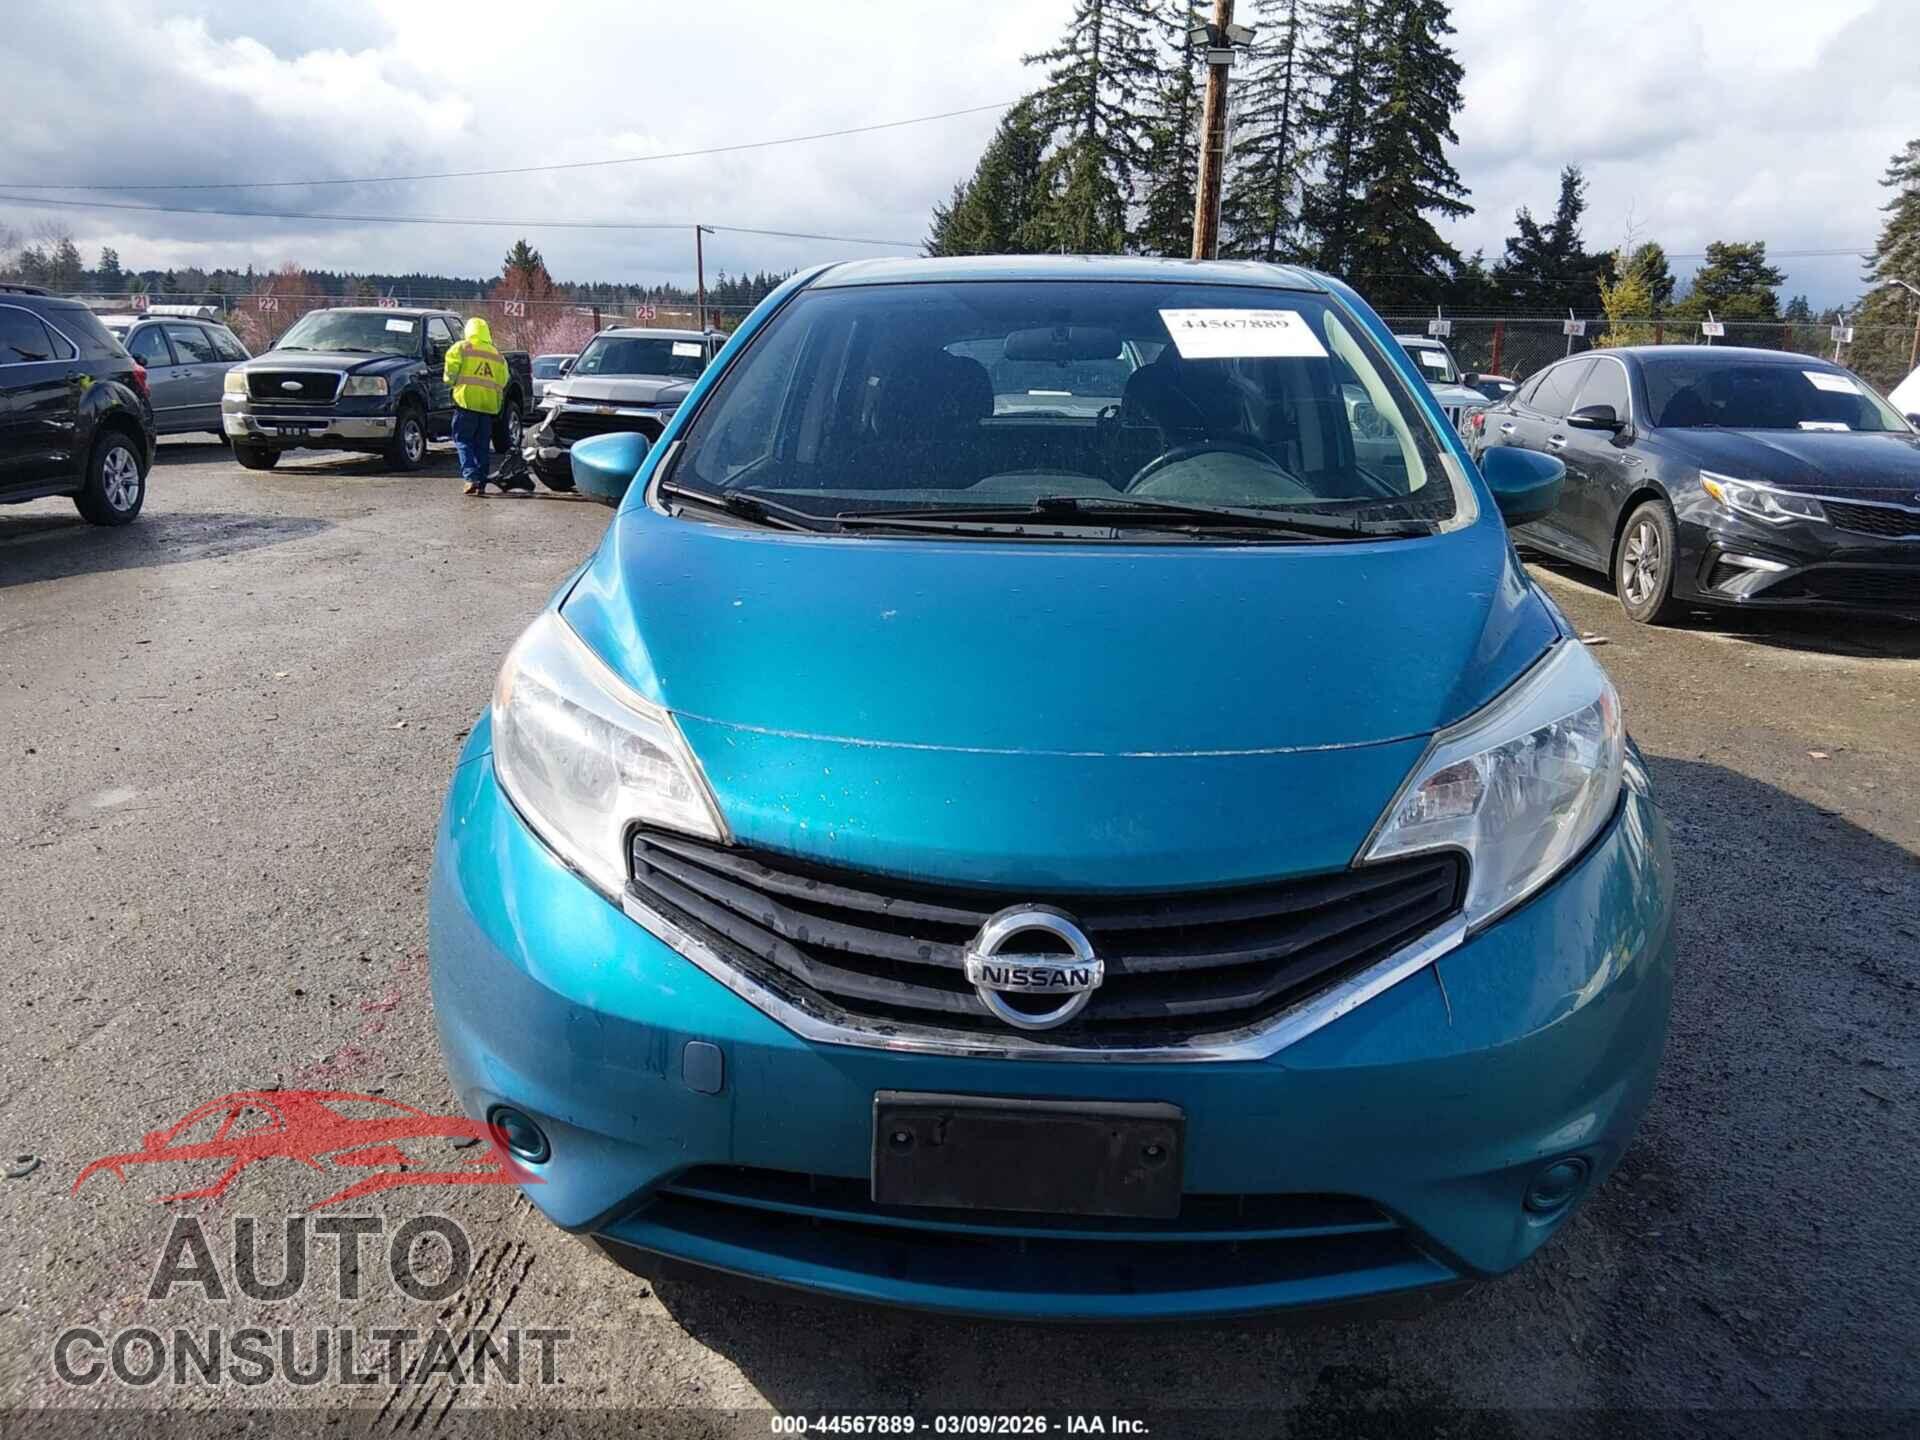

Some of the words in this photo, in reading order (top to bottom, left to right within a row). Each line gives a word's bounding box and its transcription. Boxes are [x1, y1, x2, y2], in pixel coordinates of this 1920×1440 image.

[260, 299, 277, 311] 22
[506, 303, 523, 315] 24
[638, 306, 655, 319] 25
[982, 966, 1089, 986] NISSAN
